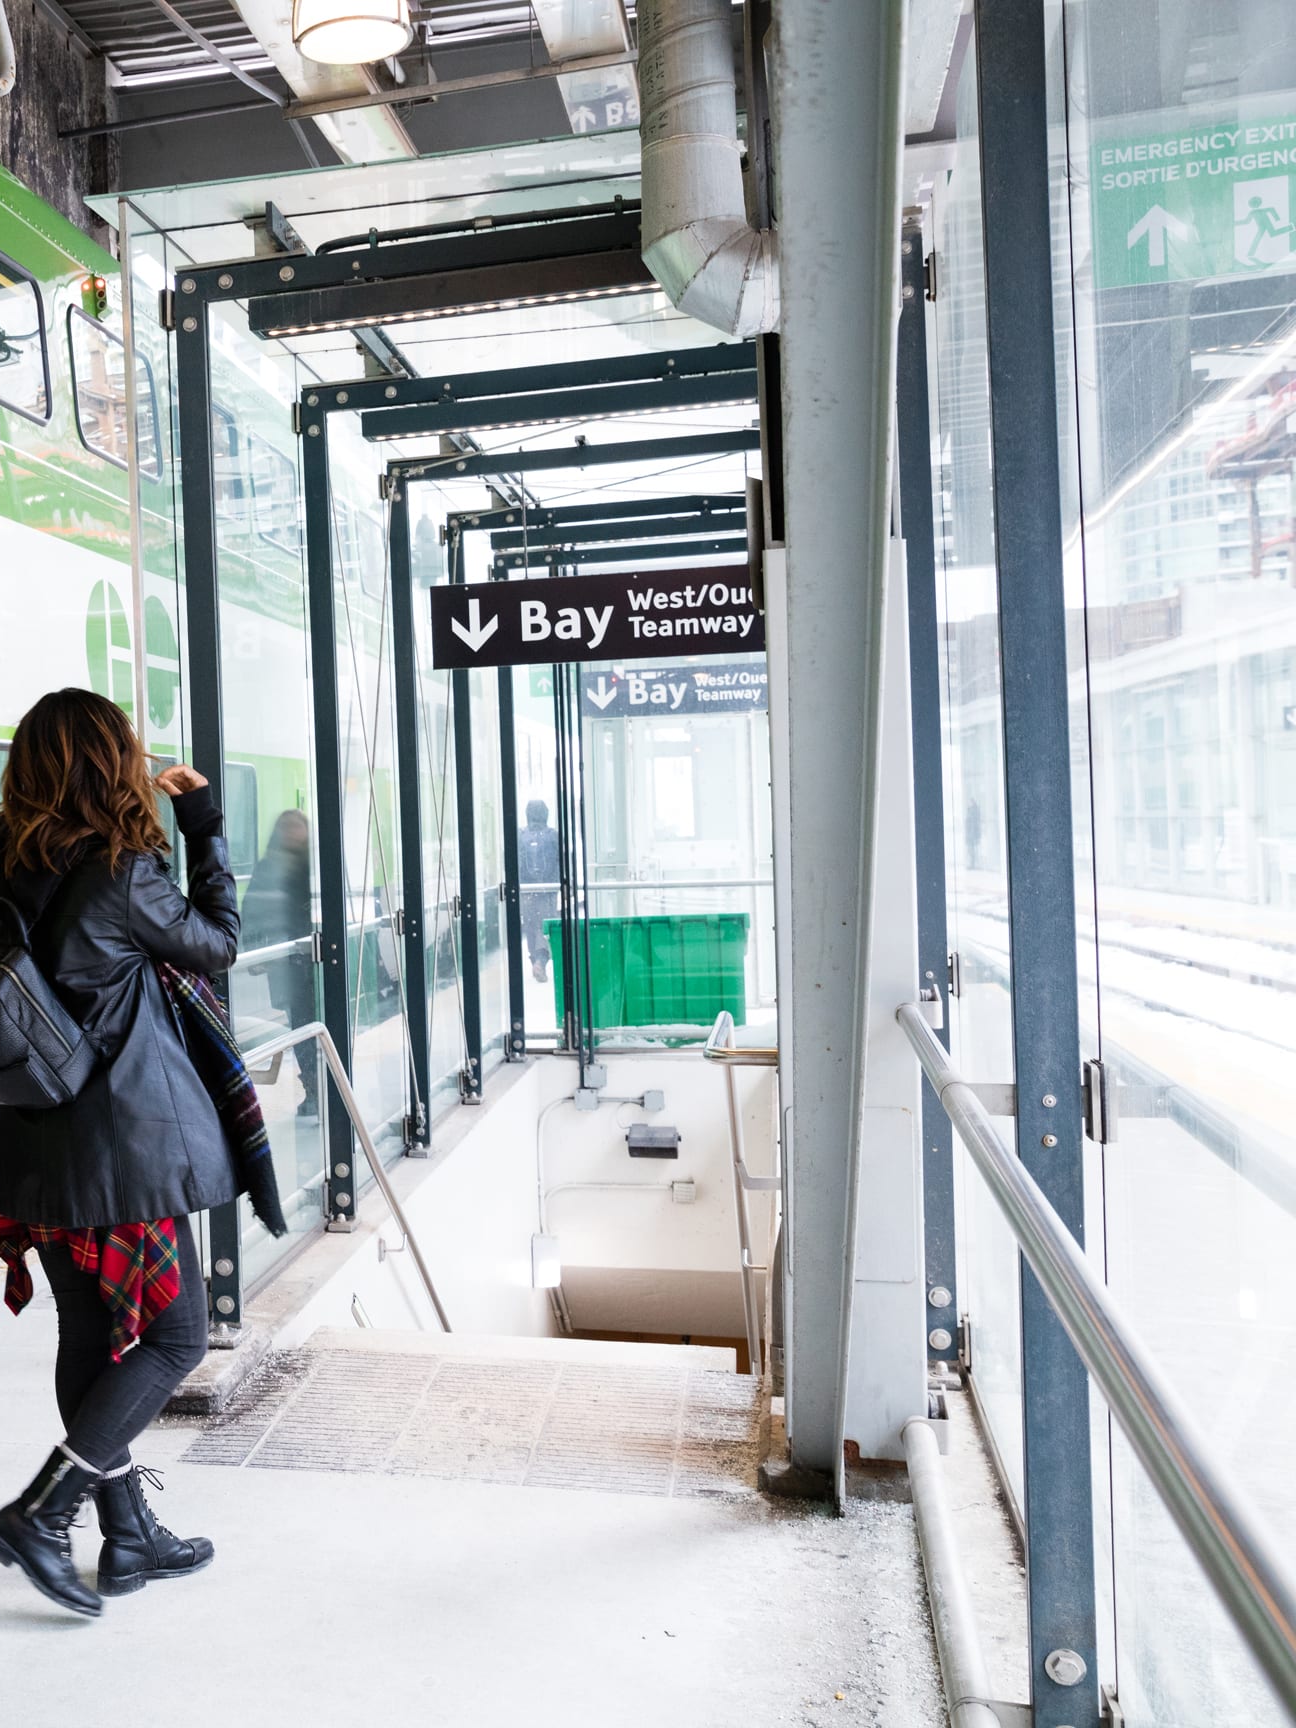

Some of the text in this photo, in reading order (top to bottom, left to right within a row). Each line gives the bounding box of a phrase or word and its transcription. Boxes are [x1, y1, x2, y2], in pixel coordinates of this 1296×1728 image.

[1101, 122, 1296, 166] EMERGENCY EXIT
[1102, 164, 1180, 191] SORTIE
[520, 600, 614, 649] Bay
[627, 614, 755, 638] Teamway
[694, 672, 768, 687] West/Oue
[629, 680, 687, 710] Bay
[694, 688, 762, 705] Teamway
